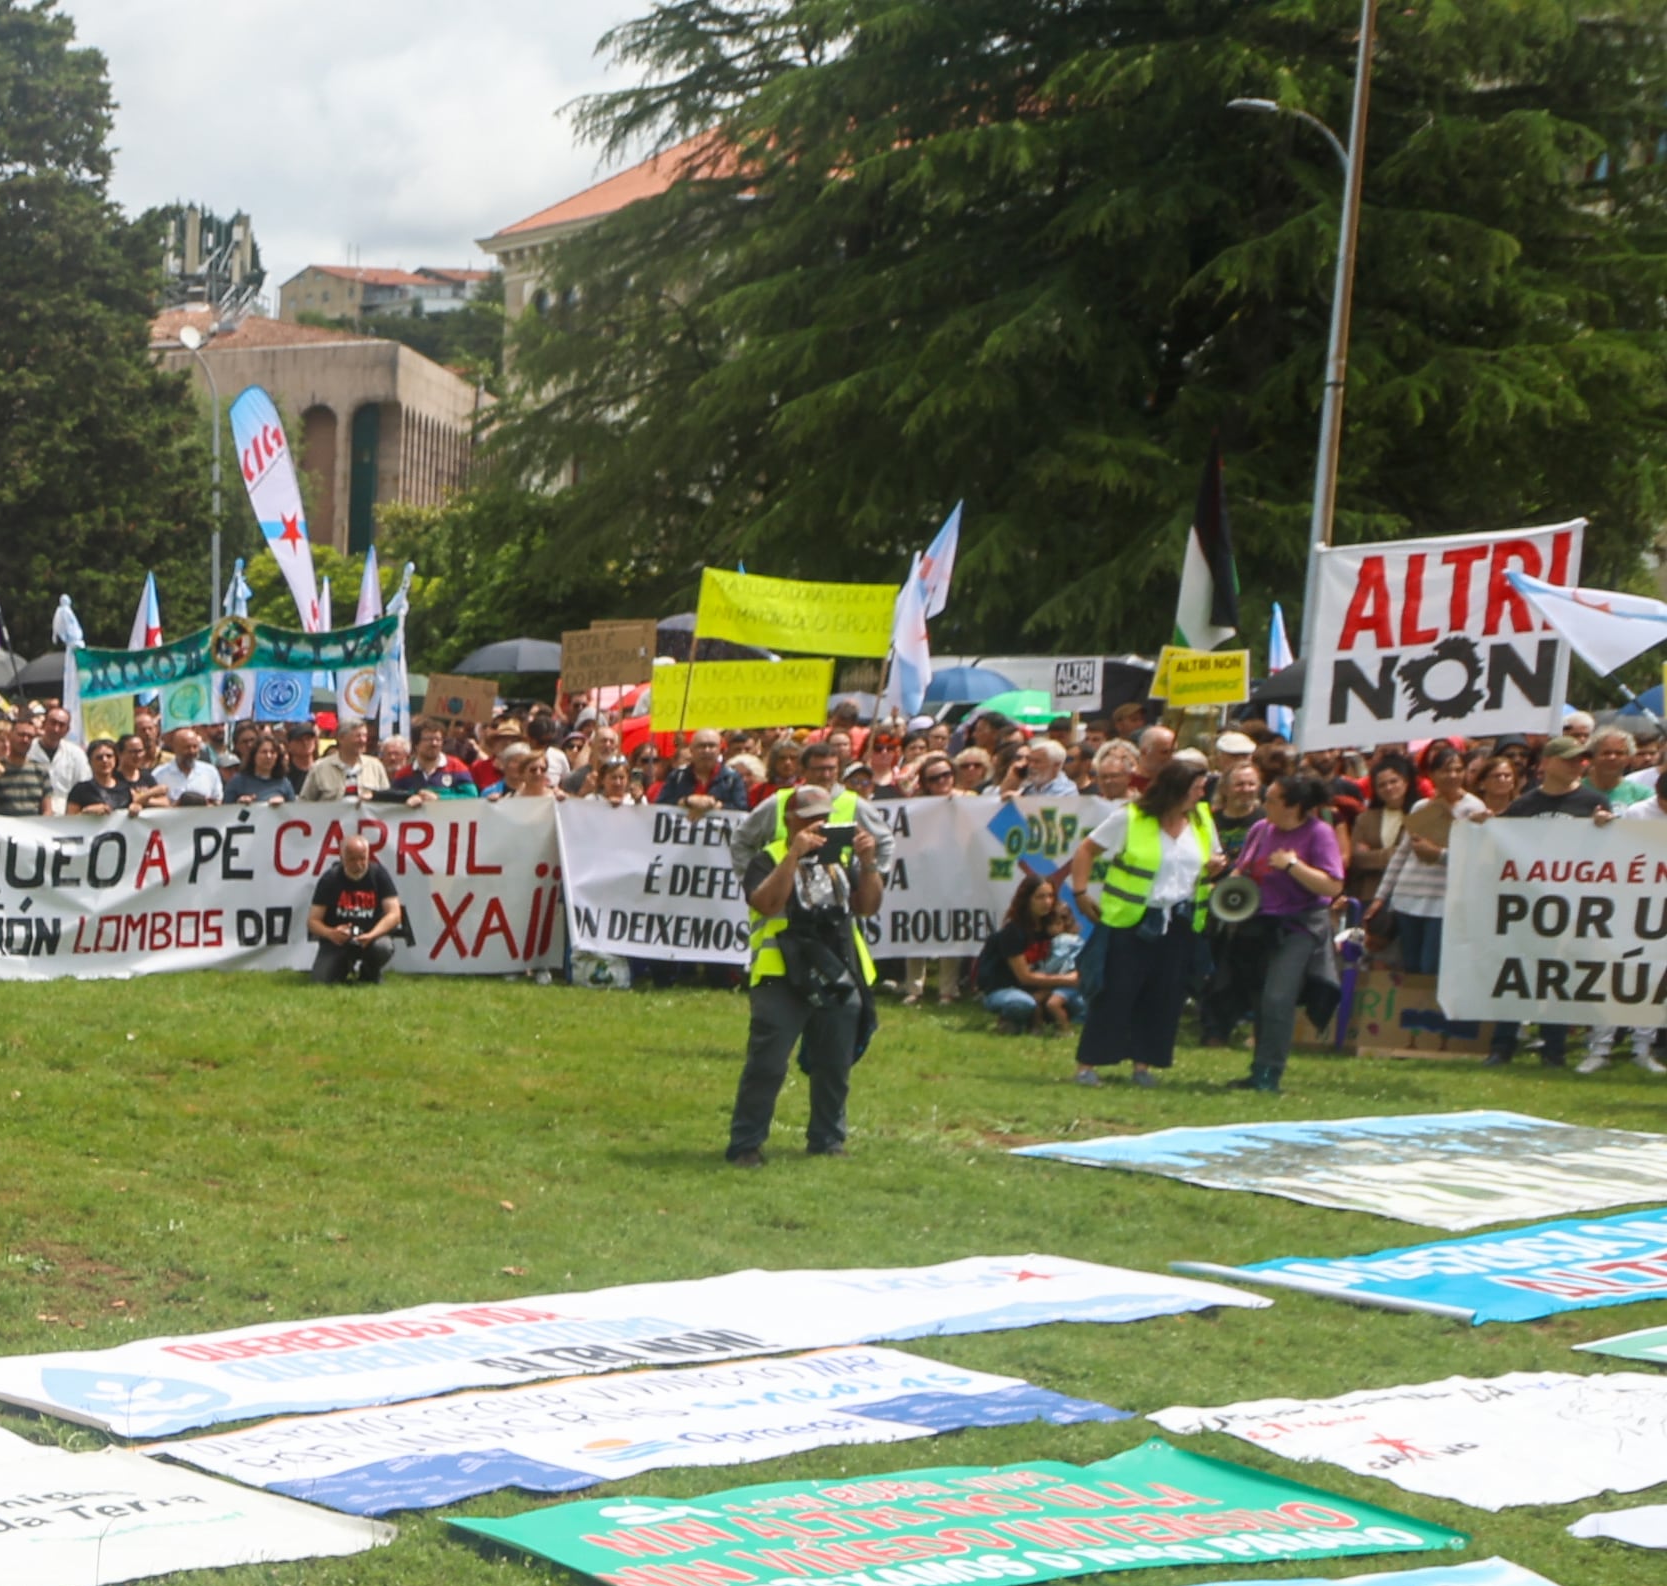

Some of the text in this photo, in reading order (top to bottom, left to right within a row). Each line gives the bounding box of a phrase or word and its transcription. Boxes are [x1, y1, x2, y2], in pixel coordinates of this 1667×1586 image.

[1337, 531, 1573, 650] ALTRI
[1328, 637, 1560, 725] NON
[134, 830, 172, 890] A
[189, 808, 256, 883] PÉ
[652, 810, 744, 848] DEFEN
[643, 856, 743, 900] É DEFE
[1500, 859, 1519, 882] A
[1526, 860, 1617, 883] AUGA
[1627, 853, 1647, 883] É
[73, 908, 224, 954] LOMBOS
[236, 905, 294, 947] DO
[607, 908, 750, 952] DEIXEMOS
[891, 906, 999, 944] ROUBEN
[1496, 893, 1616, 939] POR
[579, 1516, 745, 1558] NIN
